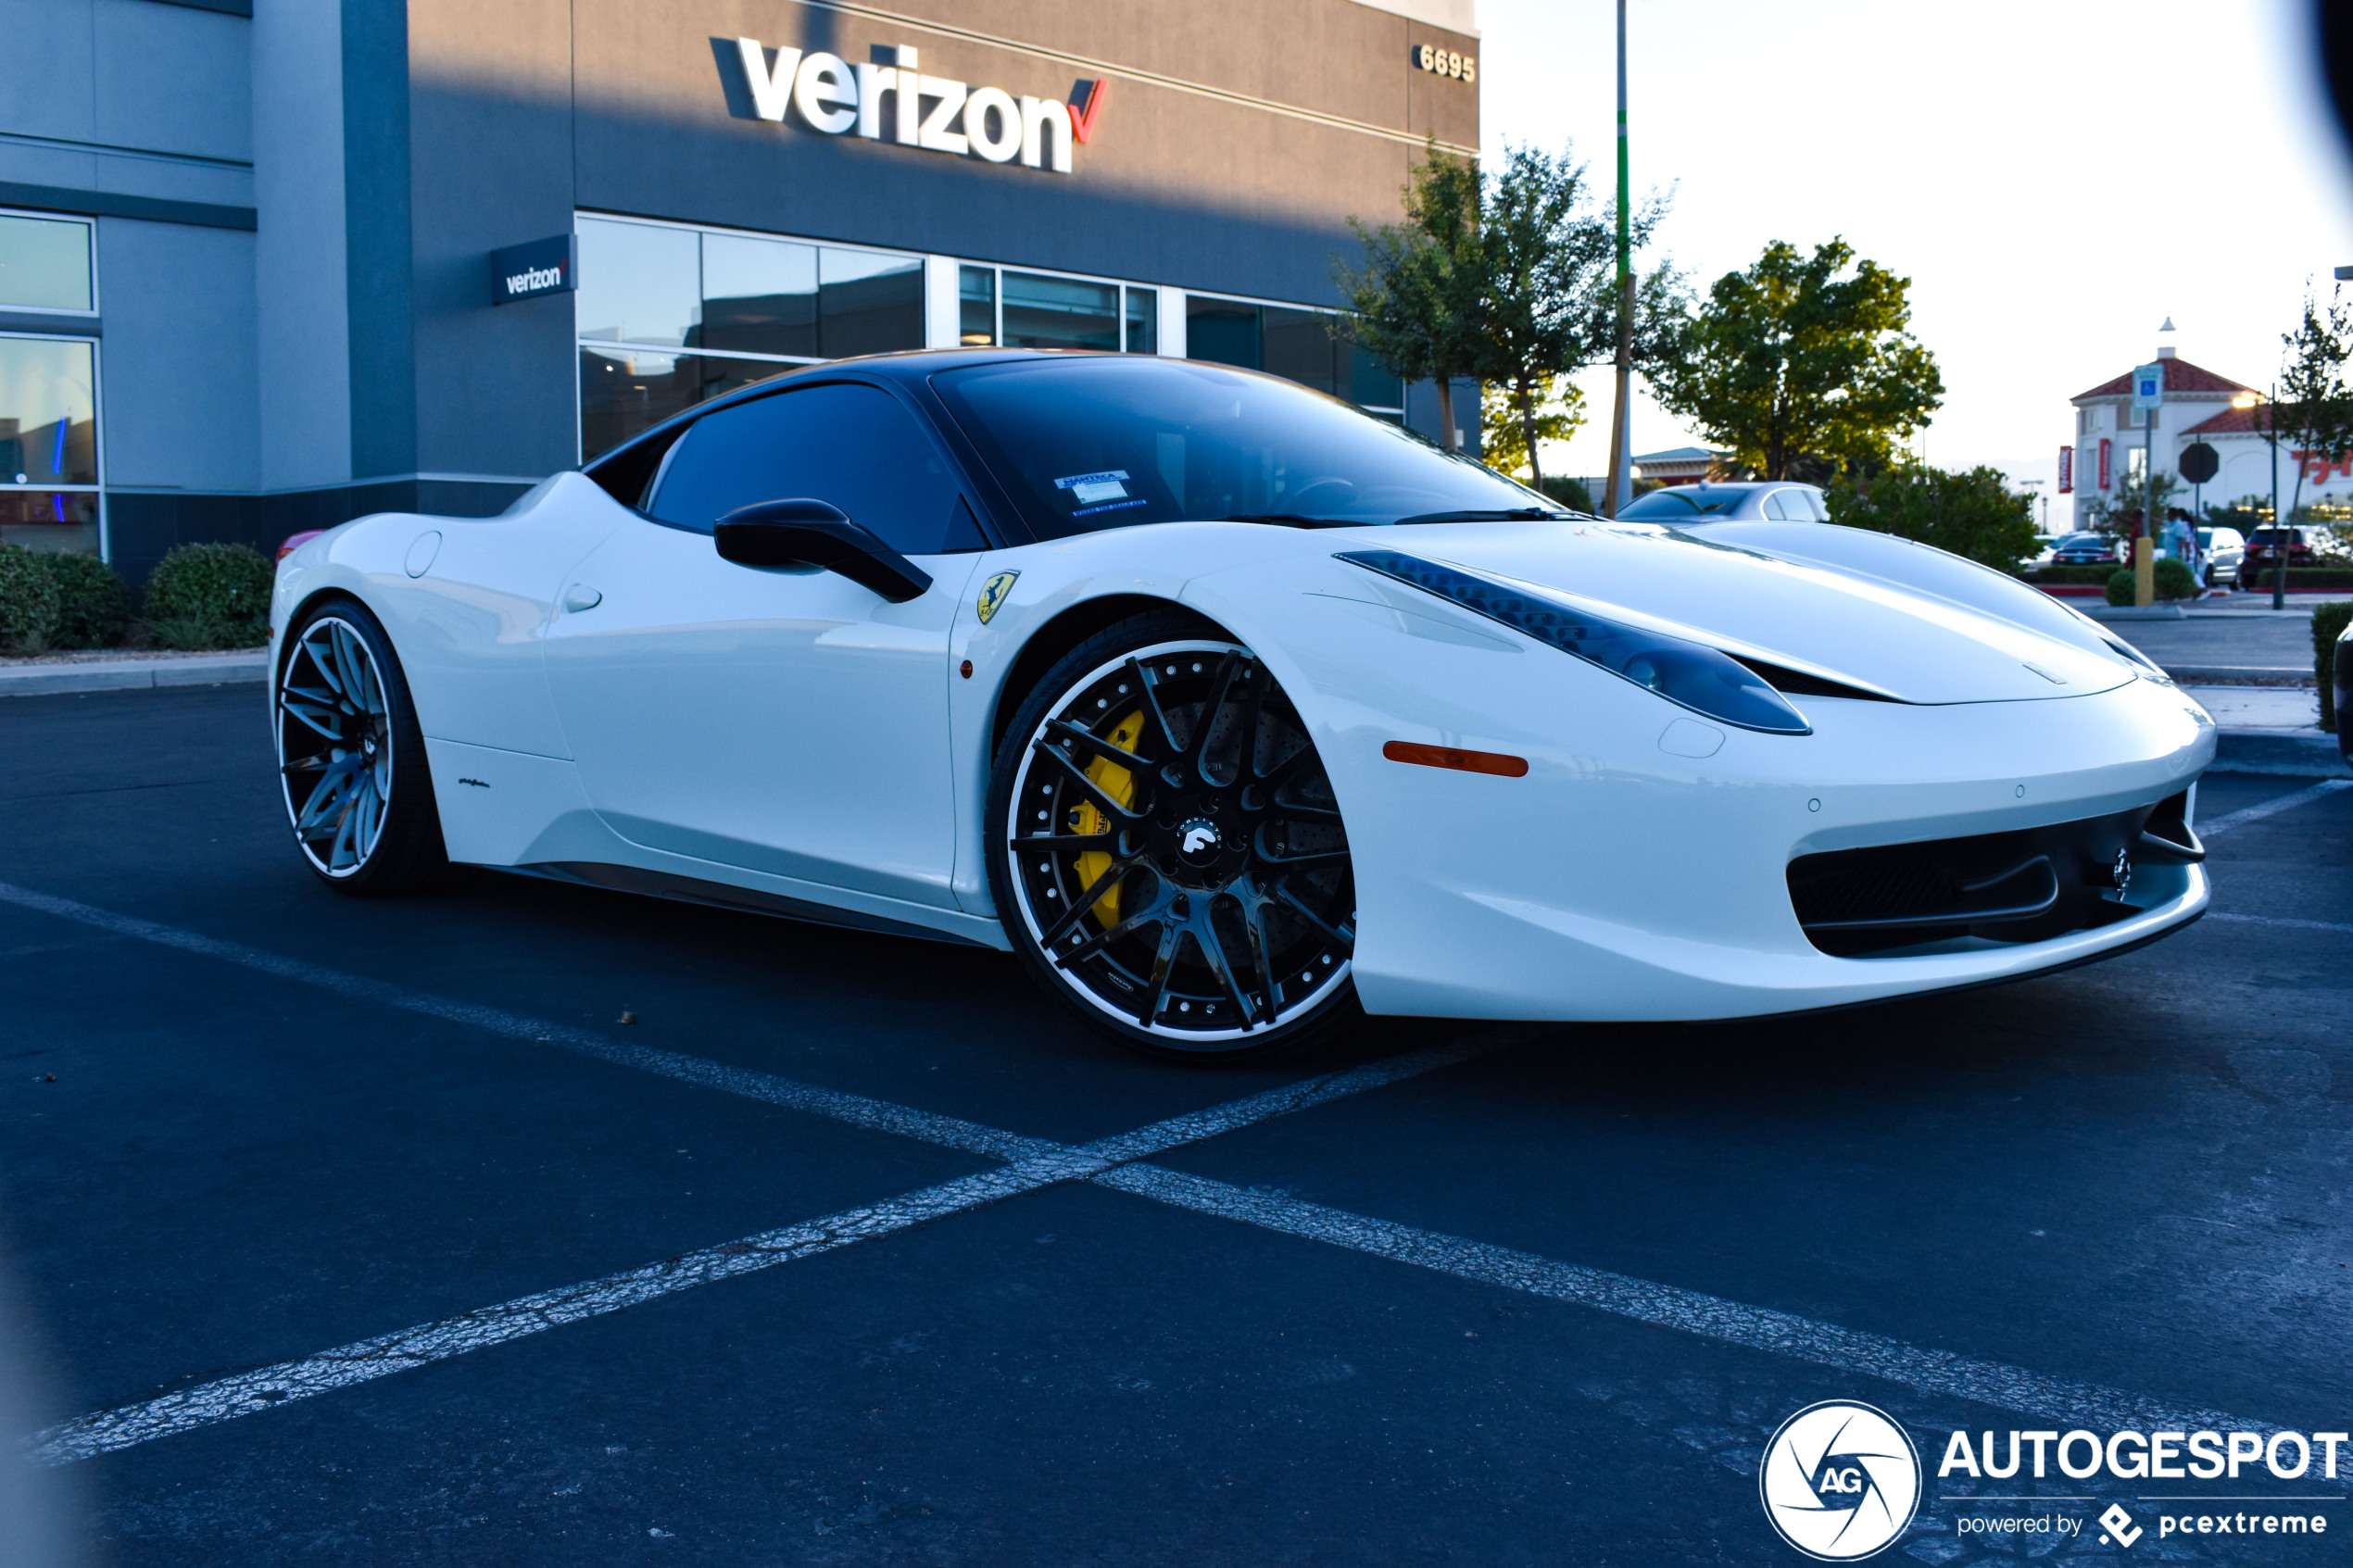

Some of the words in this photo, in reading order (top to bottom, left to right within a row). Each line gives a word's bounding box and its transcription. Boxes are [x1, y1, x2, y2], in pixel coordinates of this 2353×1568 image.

[1420, 44, 1475, 82] 6695
[736, 37, 1073, 173] verizon
[506, 267, 560, 294] verizon
